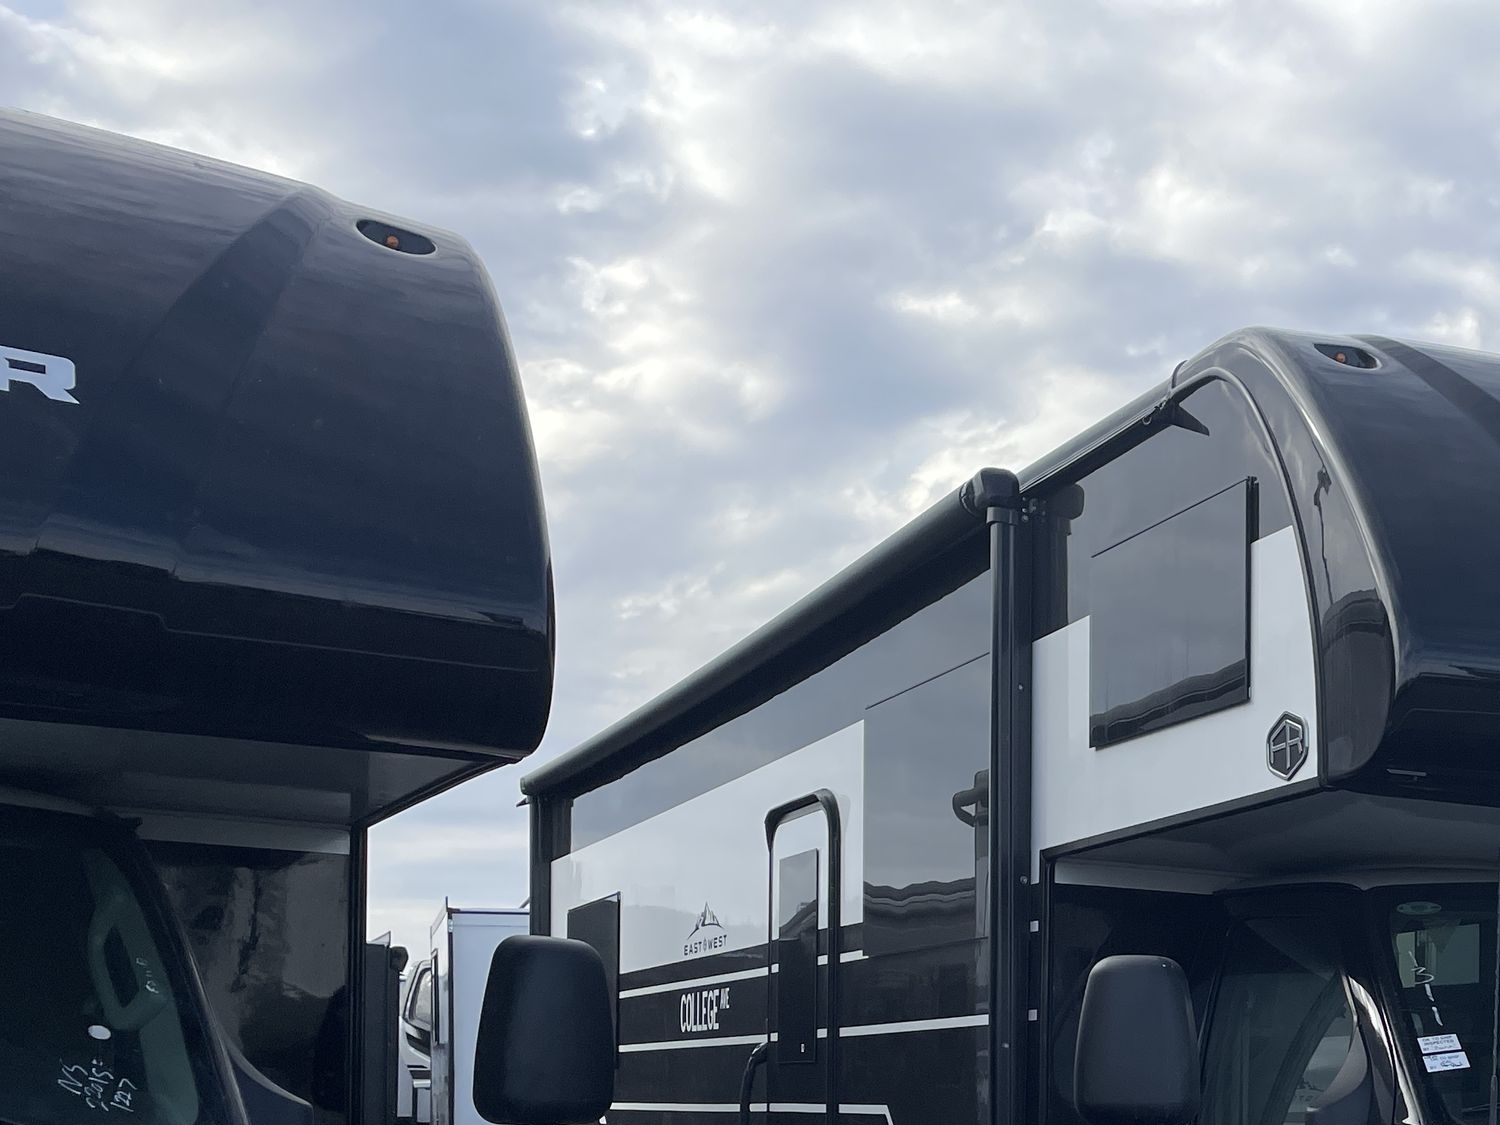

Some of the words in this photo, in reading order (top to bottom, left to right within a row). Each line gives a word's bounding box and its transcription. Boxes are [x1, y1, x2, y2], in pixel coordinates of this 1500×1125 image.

[684, 942, 702, 956] EAST
[708, 935, 727, 949] WEST
[680, 989, 719, 1033] COLLEGE
[720, 987, 730, 1009] AVE
